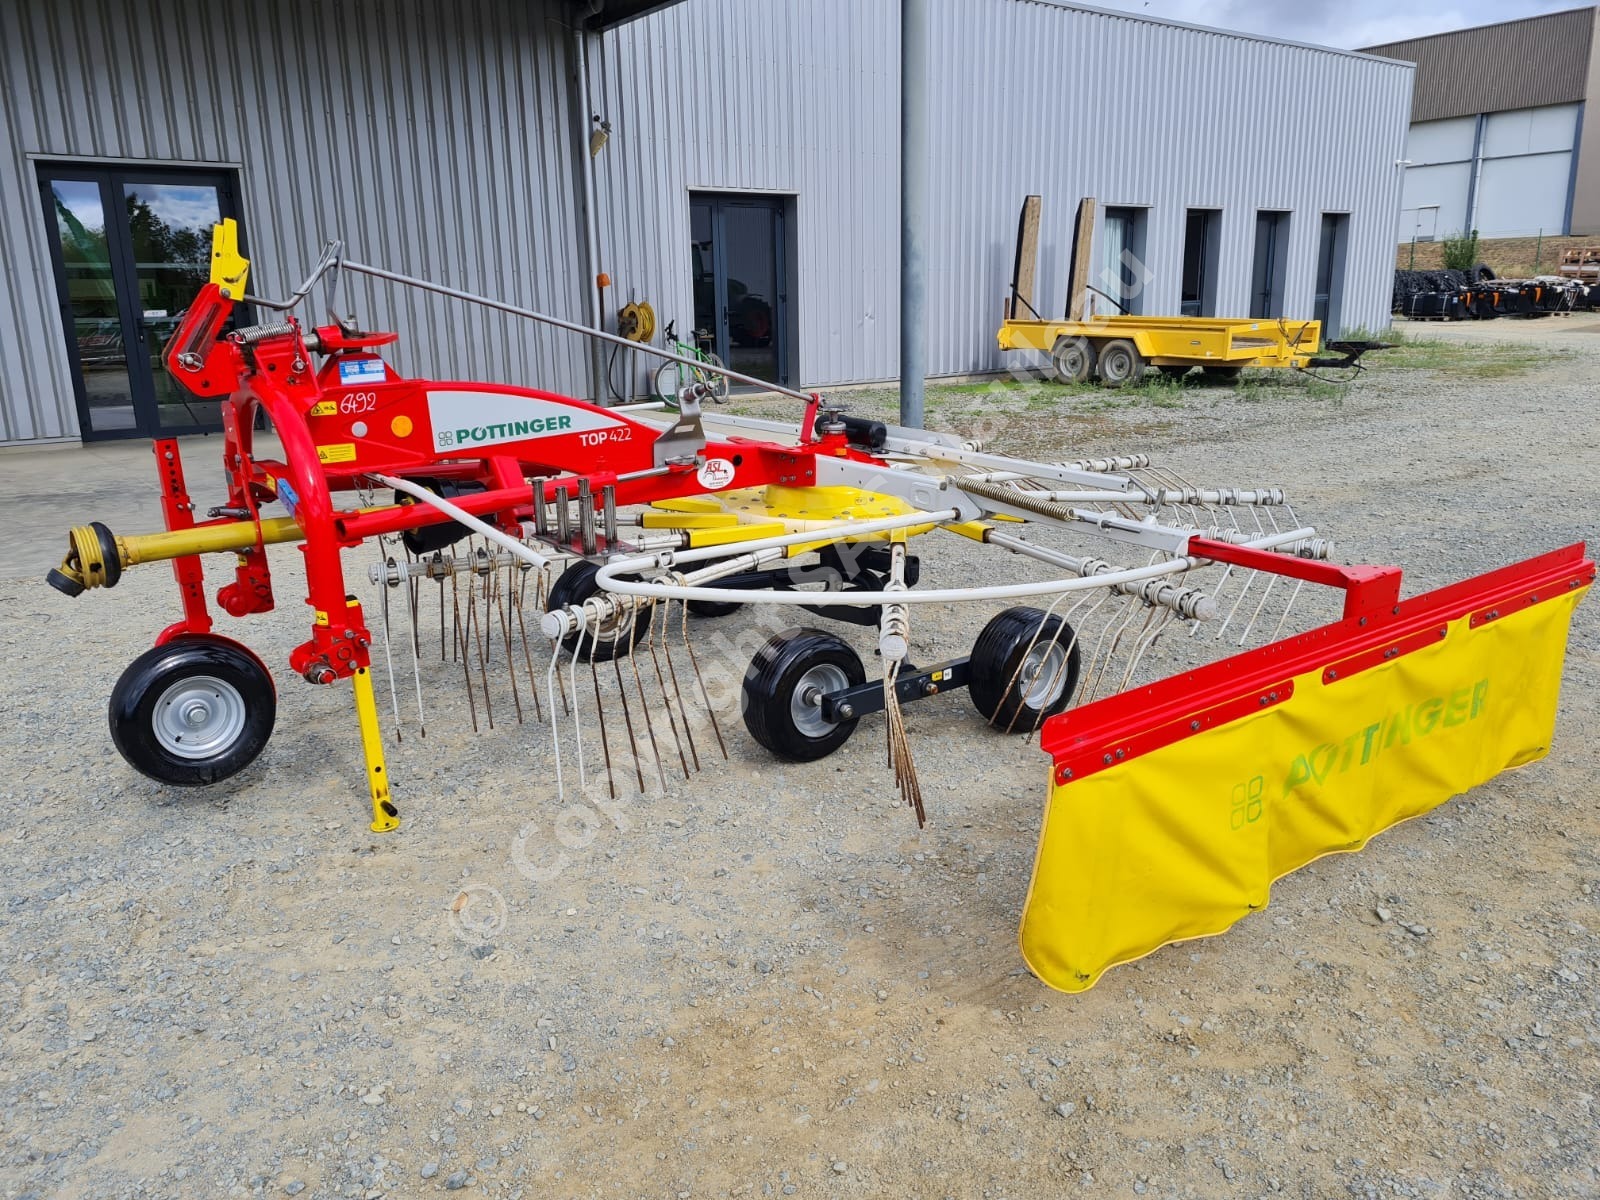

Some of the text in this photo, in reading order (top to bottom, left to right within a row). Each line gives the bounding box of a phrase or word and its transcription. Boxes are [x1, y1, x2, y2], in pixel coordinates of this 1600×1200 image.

[340, 392, 376, 414] 6492
[579, 428, 632, 447] TOP 422
